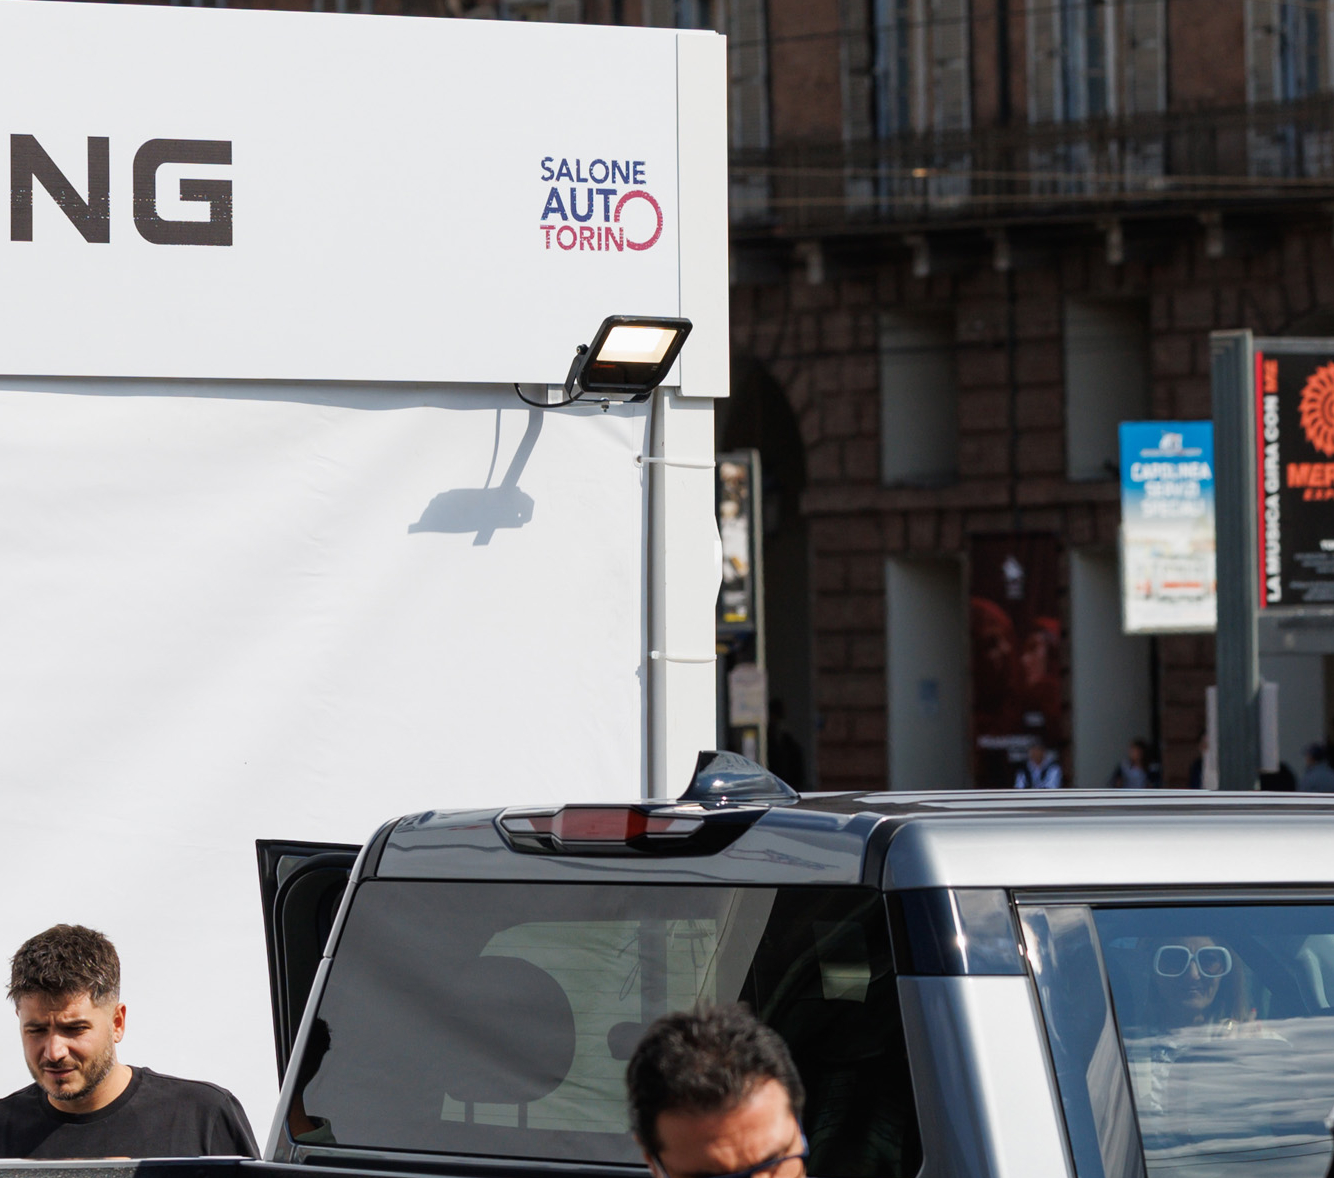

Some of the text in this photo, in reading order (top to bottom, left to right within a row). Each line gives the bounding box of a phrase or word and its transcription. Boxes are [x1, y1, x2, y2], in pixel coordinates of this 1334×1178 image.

[540, 156, 647, 185] SALONE
[540, 186, 664, 249] AUTO
[1263, 358, 1282, 603] LA MUSICA GIRA CON ME
